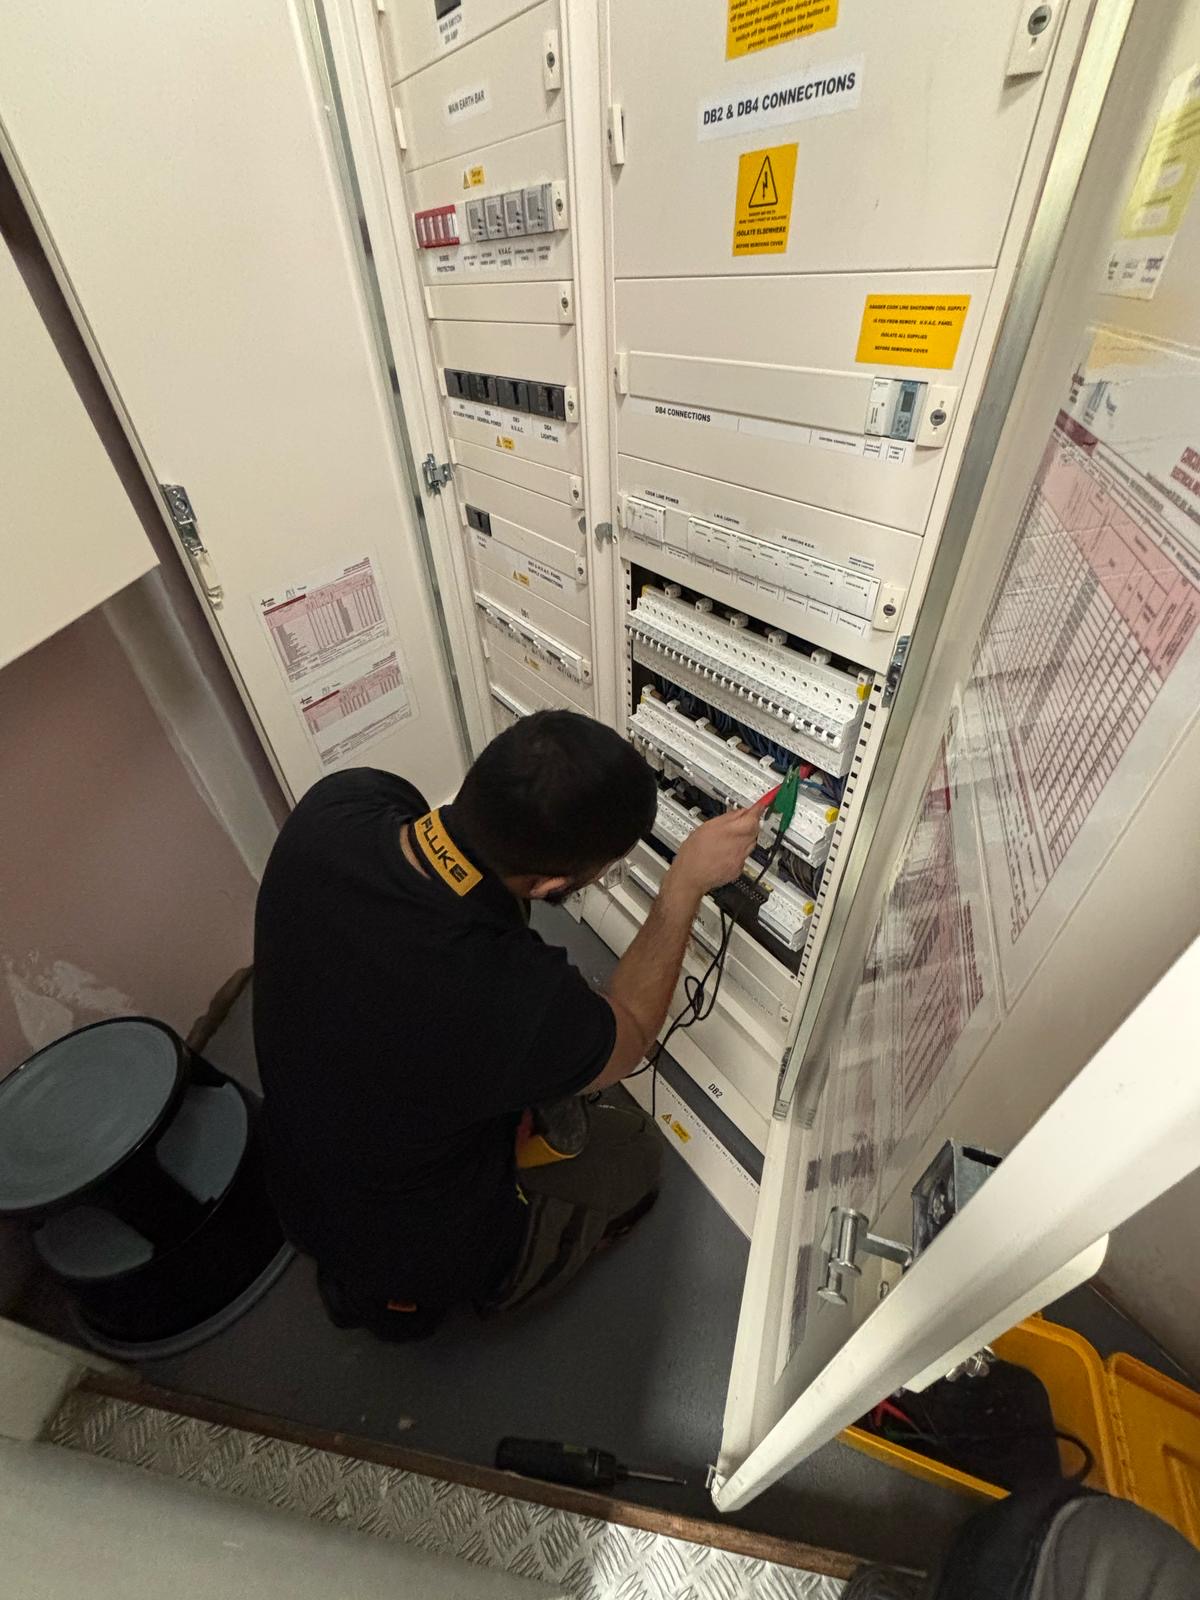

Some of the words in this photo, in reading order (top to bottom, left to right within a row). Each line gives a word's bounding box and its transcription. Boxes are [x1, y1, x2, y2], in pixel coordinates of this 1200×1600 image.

[745, 8, 760, 17] supply
[767, 23, 782, 31] supply
[806, 8, 824, 18] button
[738, 21, 753, 30] restore
[780, 28, 796, 38] expert
[797, 23, 814, 33] advice
[448, 100, 459, 115] MAIN
[459, 94, 474, 112] EARTH
[474, 90, 485, 106] BAR
[703, 107, 724, 125] DB2
[726, 104, 734, 119] &
[737, 97, 759, 117] DB4
[762, 72, 856, 111] CONNECTIONS
[736, 229, 756, 237] ISOLATE
[757, 226, 786, 235] ELSEWHERE
[655, 406, 666, 415] DB4
[667, 408, 711, 423] CONNECTIONS
[541, 433, 559, 443] LIGHTING
[665, 496, 679, 504] POWER
[420, 816, 469, 883] FLUKE
[707, 1083, 723, 1099] DB2
